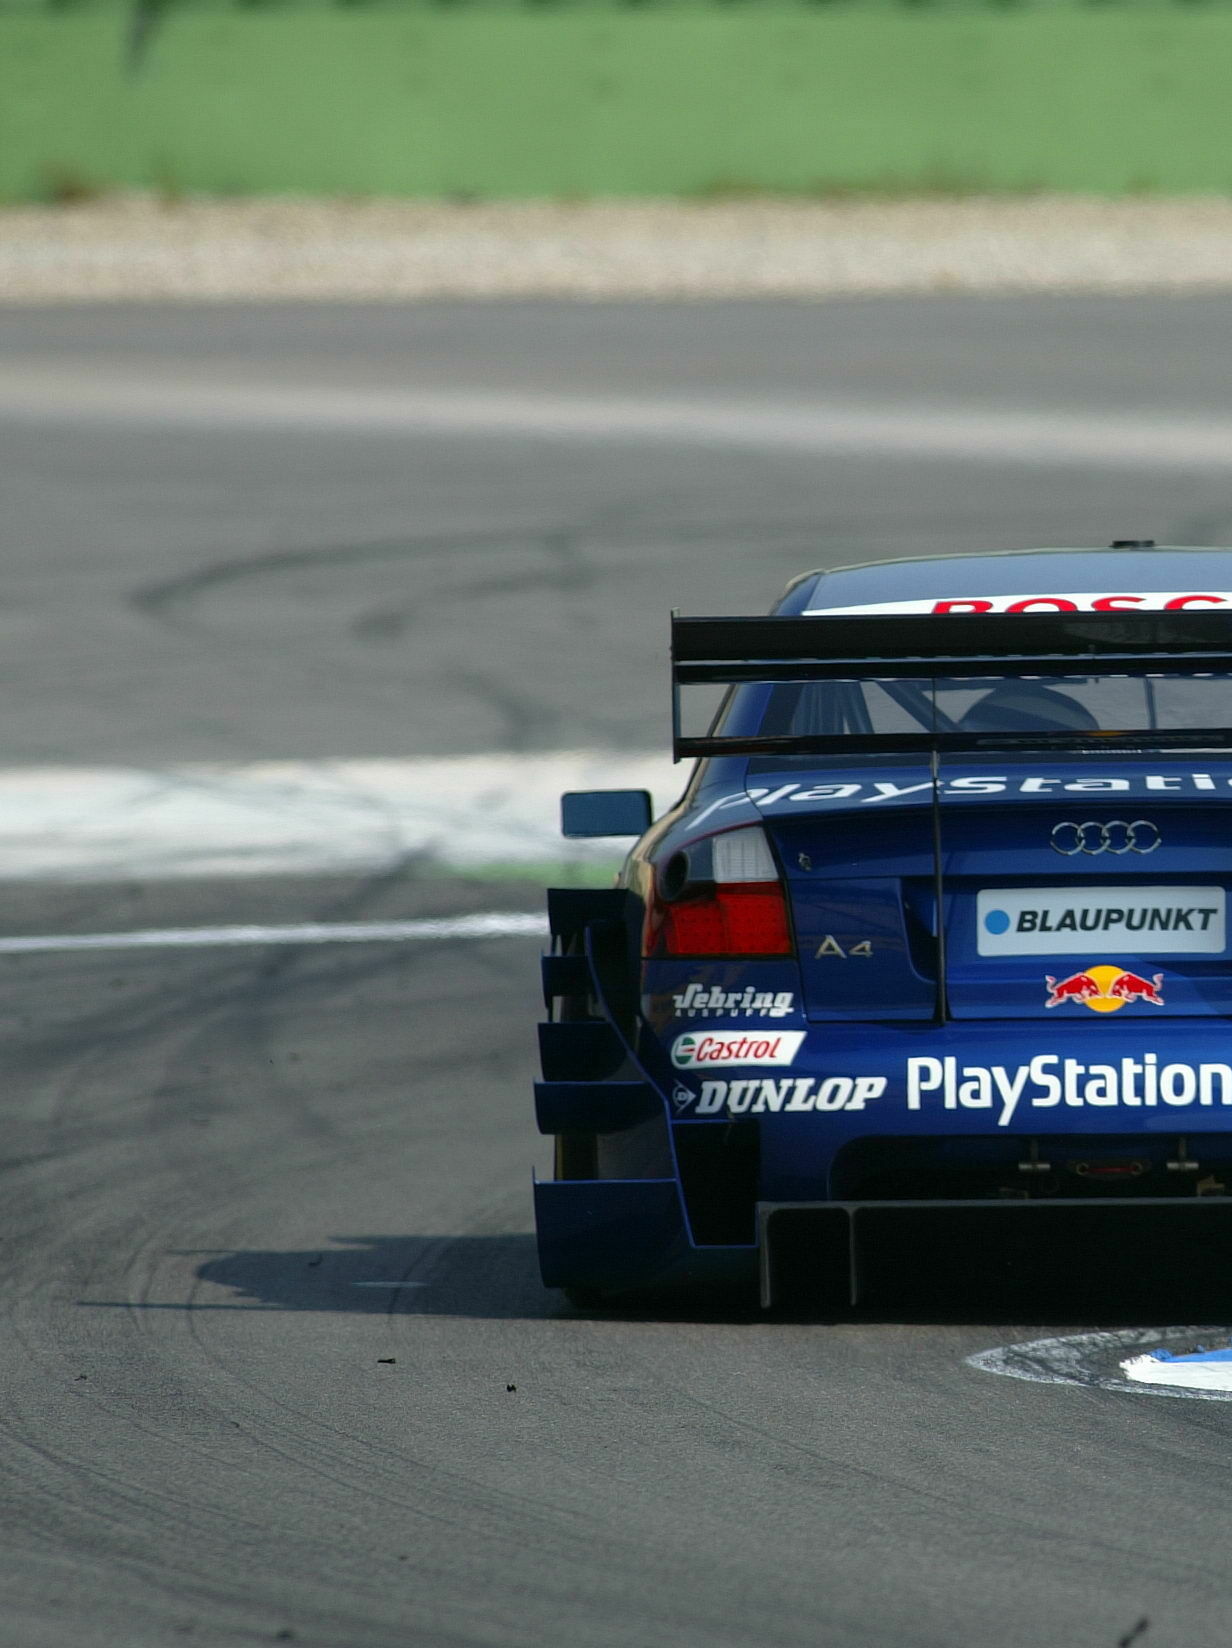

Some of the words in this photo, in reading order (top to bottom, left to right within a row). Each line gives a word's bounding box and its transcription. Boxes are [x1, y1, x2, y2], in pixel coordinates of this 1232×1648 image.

[1016, 907, 1218, 933] BLAUPUNKT
[815, 934, 873, 959] A4
[672, 983, 795, 1018] Sebring
[696, 1036, 782, 1062] Castrol
[696, 1076, 888, 1114] DUNLOP
